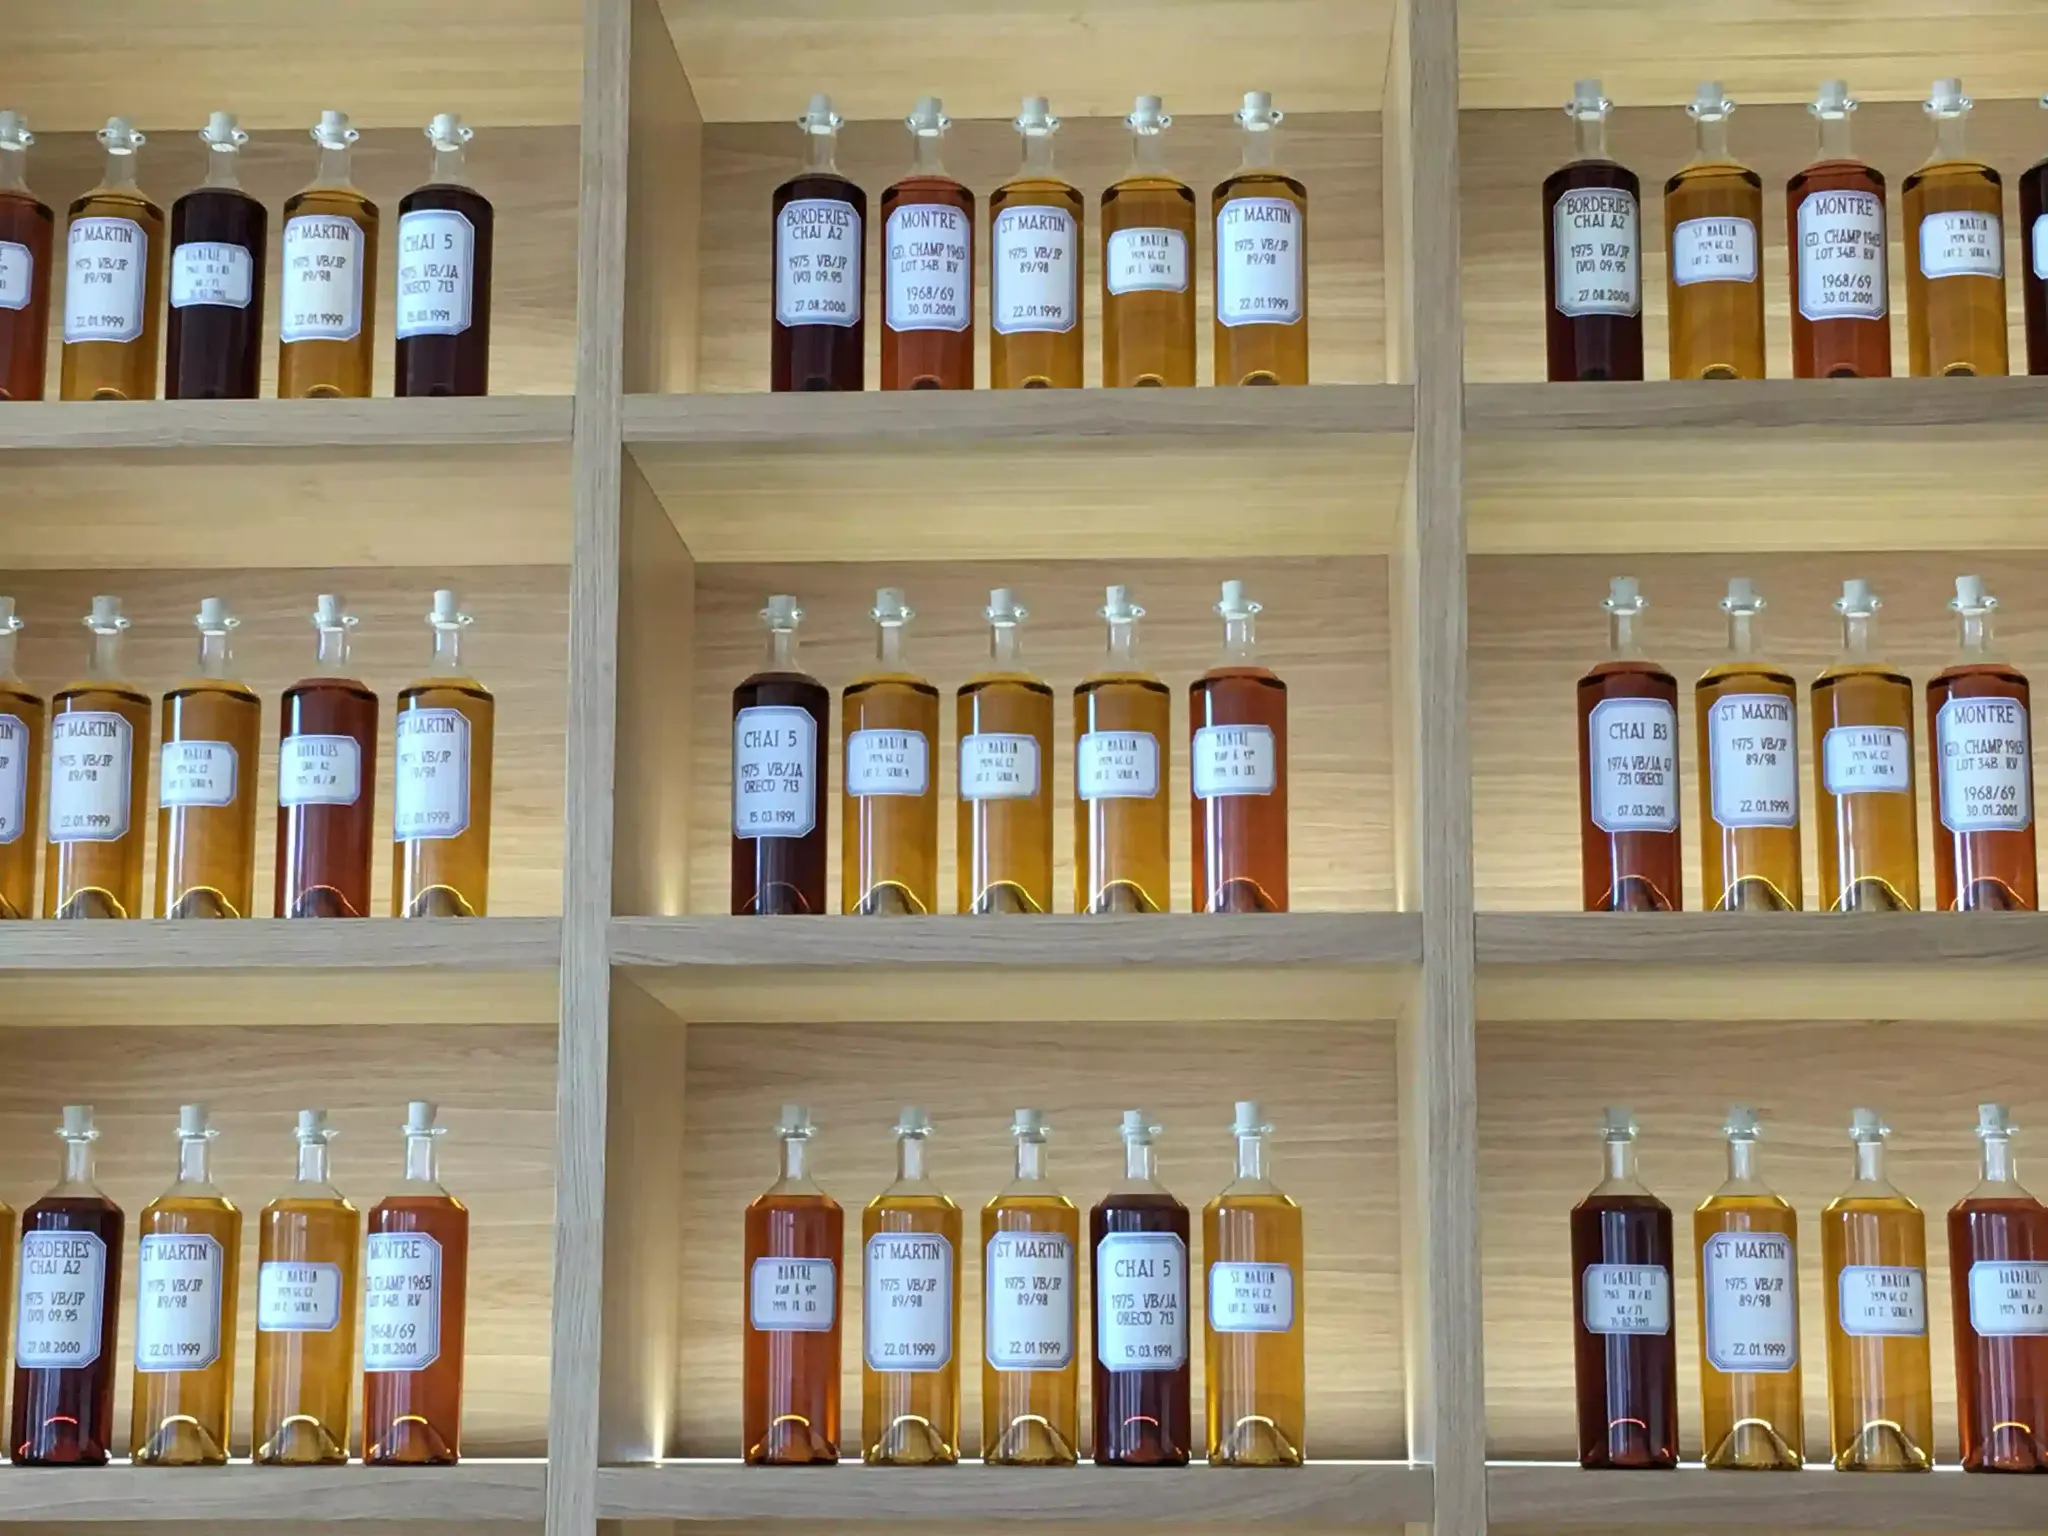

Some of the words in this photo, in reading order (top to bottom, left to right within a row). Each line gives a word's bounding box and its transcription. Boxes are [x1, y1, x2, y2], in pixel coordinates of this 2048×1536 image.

[1566, 196, 1630, 216] BORDERIES
[1816, 196, 1874, 216] MONTRE
[787, 208, 850, 227] BORDERIES
[901, 210, 957, 230] MONTRE
[1227, 208, 1240, 225] ST
[1244, 206, 1291, 224] MARTIN
[1574, 214, 1605, 228] CHAI
[1610, 216, 1625, 229] A2
[1002, 217, 1013, 234] ST
[1018, 214, 1065, 232] MARTIN
[84, 226, 134, 243] MARTIN
[302, 224, 350, 241] MARTIN
[792, 226, 822, 240] CHAI
[828, 228, 843, 240] A2
[1824, 228, 1862, 244] CHAMP
[404, 234, 434, 252] CHAI
[444, 234, 452, 250] 5
[909, 242, 945, 257] CHAMP
[1234, 238, 1254, 252] 1975
[1260, 238, 1289, 252] VB/JP
[1570, 244, 1594, 257] 1975
[1600, 242, 1630, 258] VB/JP
[1008, 247, 1028, 260] 1975
[1034, 246, 1063, 260] VB/JP
[1816, 246, 1834, 260] LOT
[98, 257, 128, 270] VB/JP
[316, 255, 346, 268] VB/JP
[789, 255, 809, 269] 1975
[816, 254, 848, 269] VB/JP
[901, 260, 918, 273] LOT
[946, 262, 958, 274] RV
[1020, 262, 1049, 274] 89/98
[423, 264, 459, 278] VB/JA
[1822, 273, 1872, 288] 1968/69
[906, 286, 954, 300] 1968/69
[1721, 706, 1736, 722] ST
[1742, 704, 1788, 720] MARTIN
[1954, 705, 2014, 726] MONTRE
[69, 720, 117, 738] MARTIN
[1609, 722, 1645, 740] CHAI
[1654, 723, 1668, 740] B3
[744, 730, 779, 748] CHAI
[788, 730, 797, 748] 5
[1732, 738, 1754, 751] 1975
[1964, 739, 2002, 754] CHAMP
[82, 754, 114, 766] VB/JP
[422, 750, 452, 764] VB/JP
[1608, 756, 1628, 772] 1974
[1631, 756, 1662, 772] VB/JA
[1745, 754, 1776, 766] 89/98
[1956, 757, 1974, 771] LOT
[742, 763, 760, 778] 1975
[767, 762, 804, 778] VB/JA
[744, 779, 776, 794] ORECO
[783, 779, 800, 793] 713
[1964, 786, 2016, 802] 1968/69
[26, 1240, 92, 1258] BORDERIES
[158, 1244, 208, 1260] MARTIN
[874, 1244, 886, 1260] ST
[890, 1243, 941, 1260] MARTIN
[997, 1241, 1011, 1258] ST
[1015, 1240, 1064, 1259] MARTIN
[1715, 1242, 1731, 1259] ST
[1735, 1242, 1785, 1260] MARTIN
[30, 1260, 57, 1275] CHAI
[63, 1260, 80, 1274] A2
[1115, 1258, 1154, 1278] CHAI
[1163, 1258, 1171, 1277] 5
[172, 1278, 204, 1292] VB/JP
[408, 1274, 432, 1291] 1965
[880, 1279, 900, 1292] 1975
[906, 1278, 937, 1292] VB/JP
[1004, 1278, 1026, 1290] 1975
[1032, 1277, 1062, 1290] VB/JP
[1725, 1278, 1748, 1290] 1975
[1754, 1278, 1784, 1292] VB/JP
[51, 1292, 86, 1306] VB/JP
[407, 1294, 422, 1307] RV
[892, 1294, 923, 1308] 89/98
[1112, 1294, 1134, 1308] 1975
[1144, 1294, 1178, 1308] VB/JA
[1738, 1294, 1772, 1308] 89/98
[48, 1308, 78, 1322] 09.95
[1116, 1311, 1152, 1326] ORECO
[1160, 1311, 1174, 1326] 713
[884, 1342, 936, 1356] 22.01.1999
[1125, 1344, 1172, 1358] 15.03.1991
[1733, 1342, 1786, 1356] 22.01.1999
